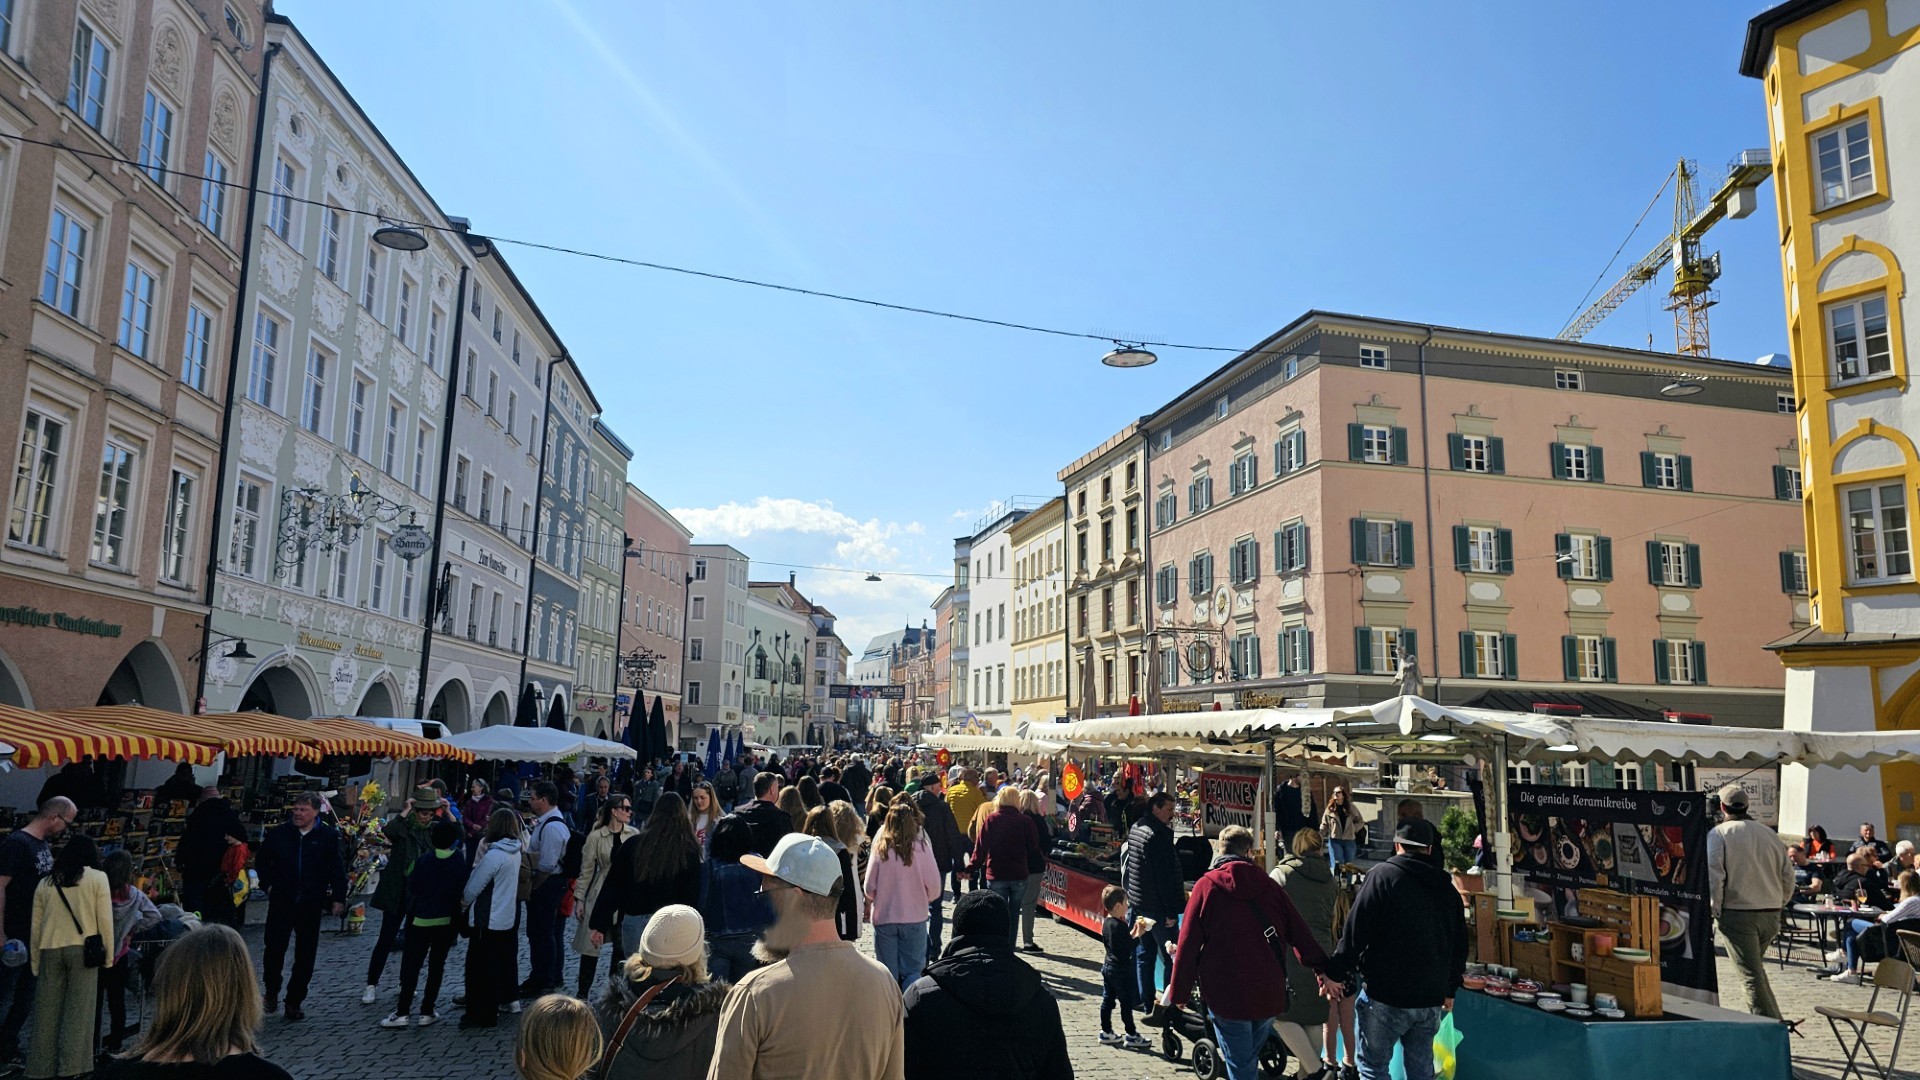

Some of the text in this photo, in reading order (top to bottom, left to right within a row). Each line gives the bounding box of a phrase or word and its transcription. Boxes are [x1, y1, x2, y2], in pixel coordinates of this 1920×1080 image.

[395, 537, 425, 548] Santa
[1204, 779, 1259, 806] PFANNEN
[1520, 791, 1637, 810] Die geniale Keramikreibe
